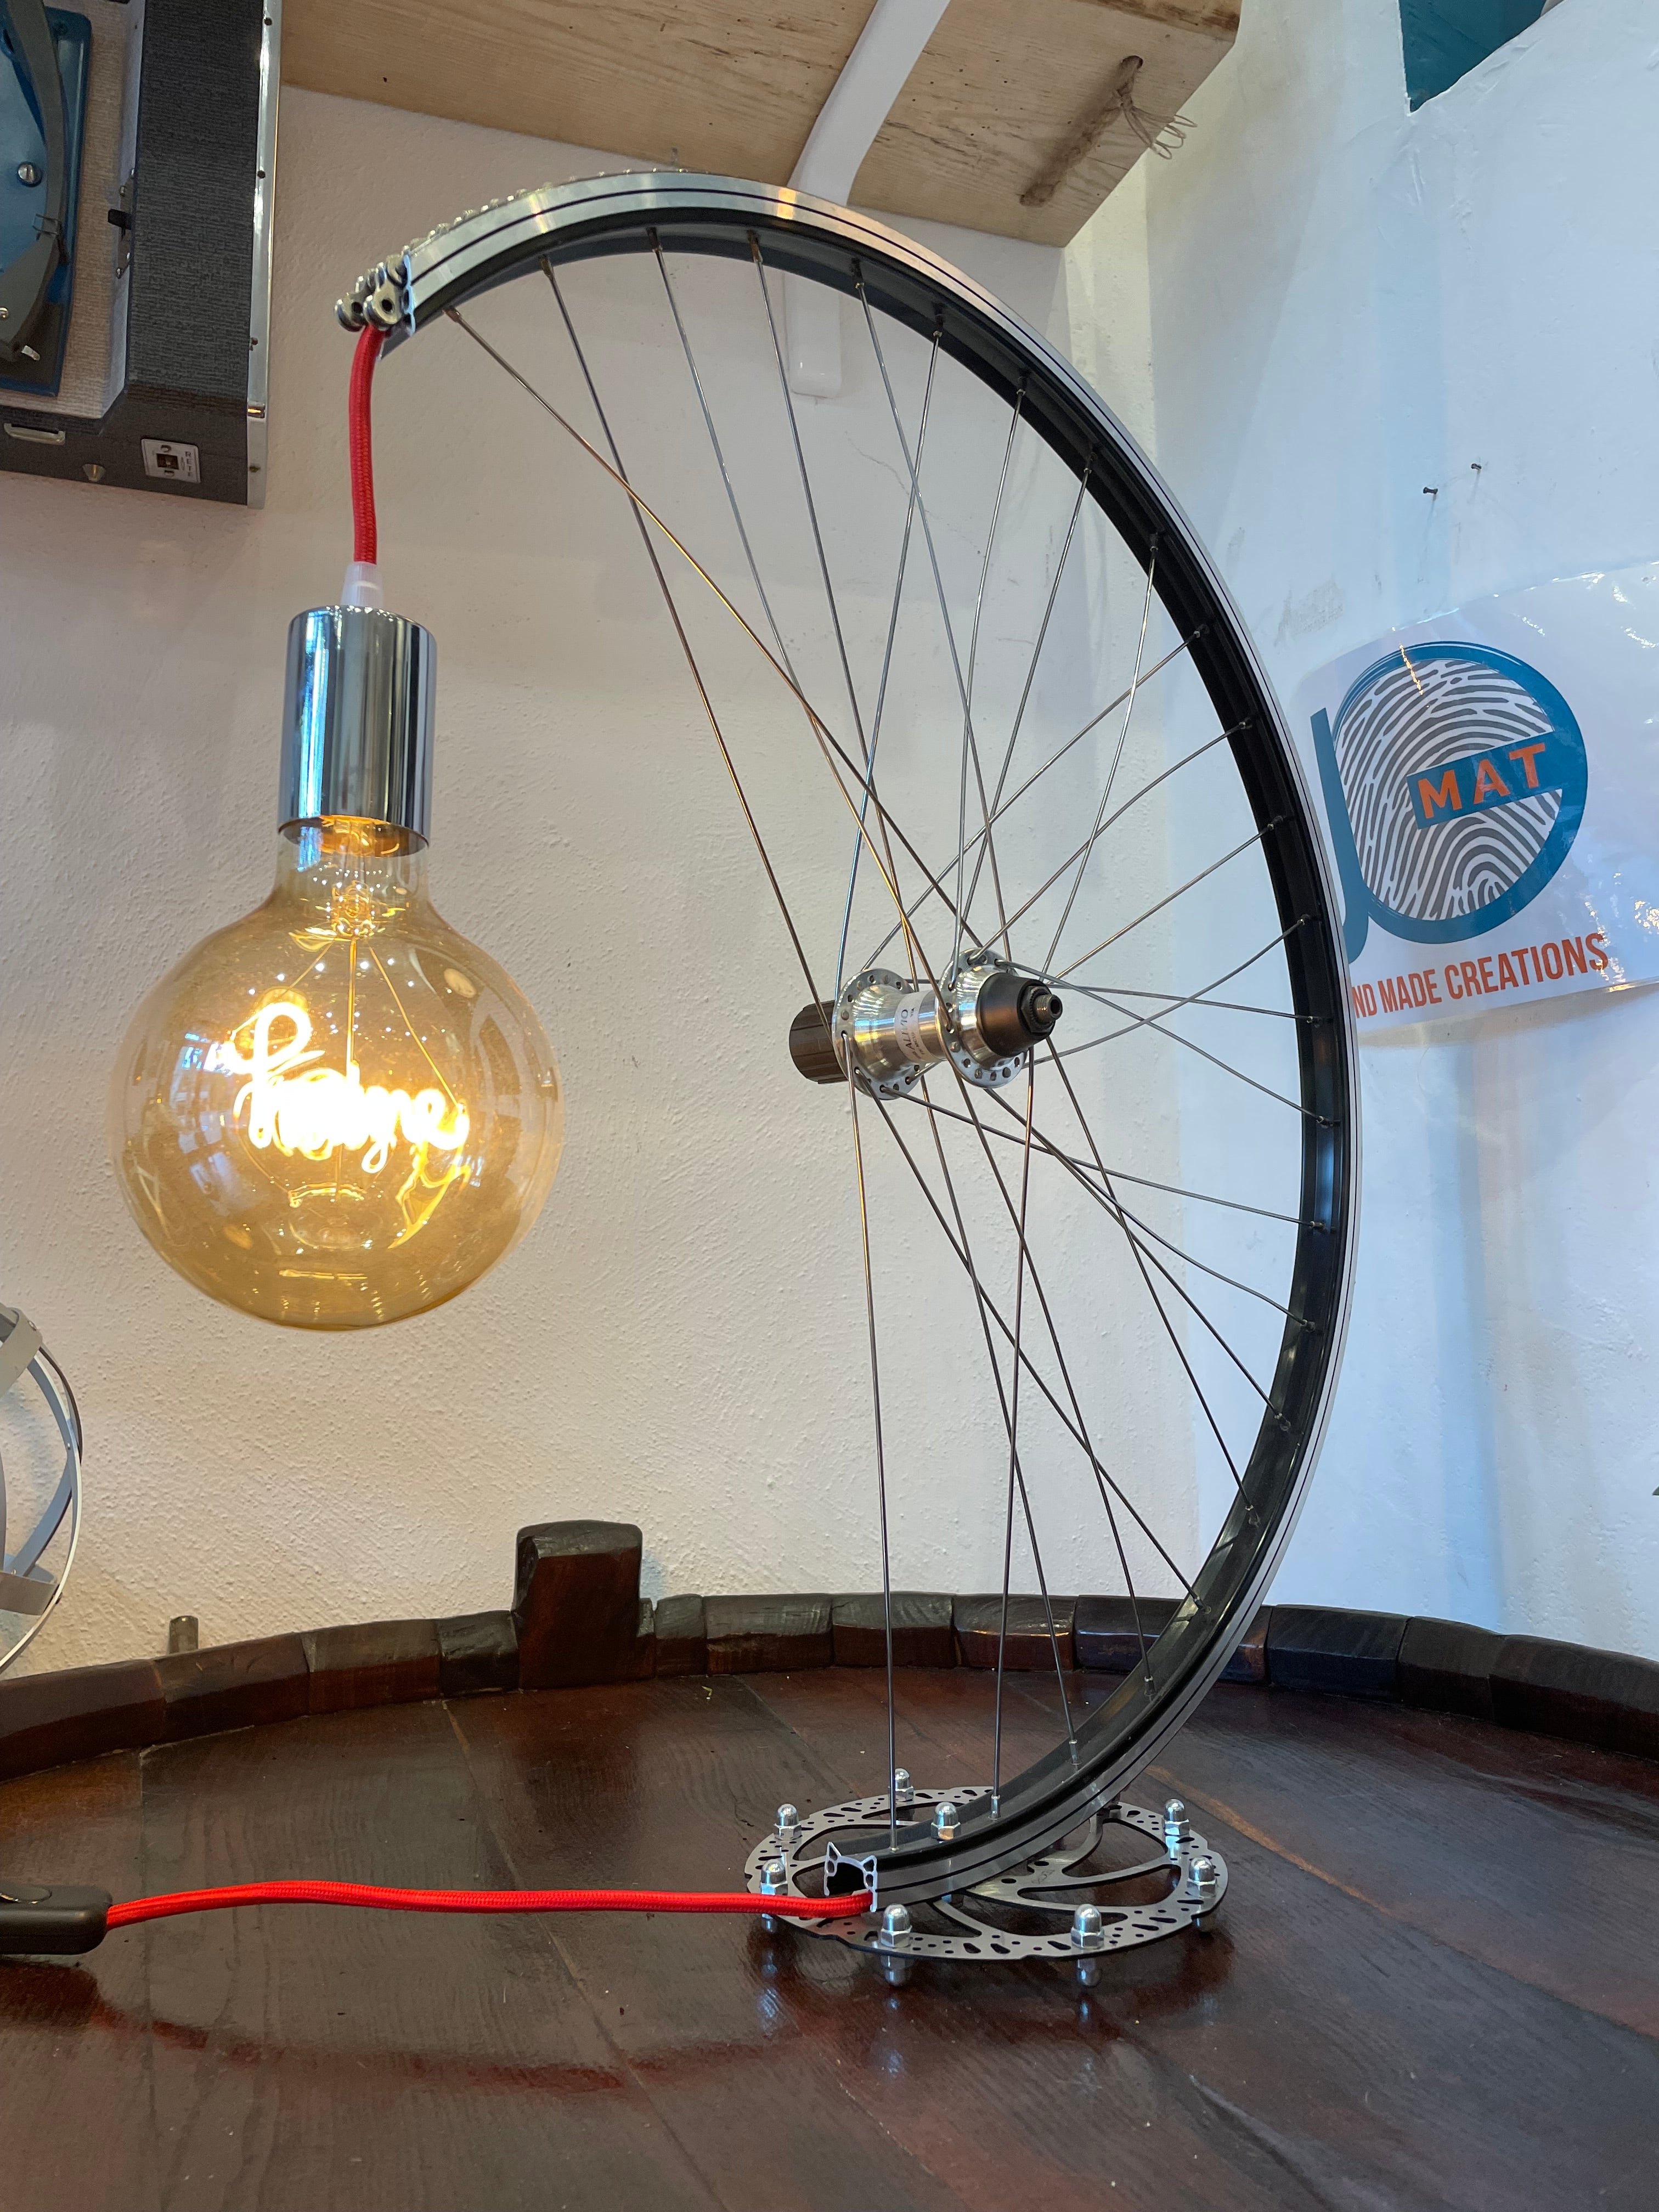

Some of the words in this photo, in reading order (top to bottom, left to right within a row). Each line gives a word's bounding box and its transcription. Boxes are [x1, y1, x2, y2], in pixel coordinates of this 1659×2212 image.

[1418, 742, 1545, 819] MAT
[1351, 983, 1378, 1019] ND
[1378, 969, 1443, 1013] MADE
[1444, 932, 1609, 1000] CREATIONS
